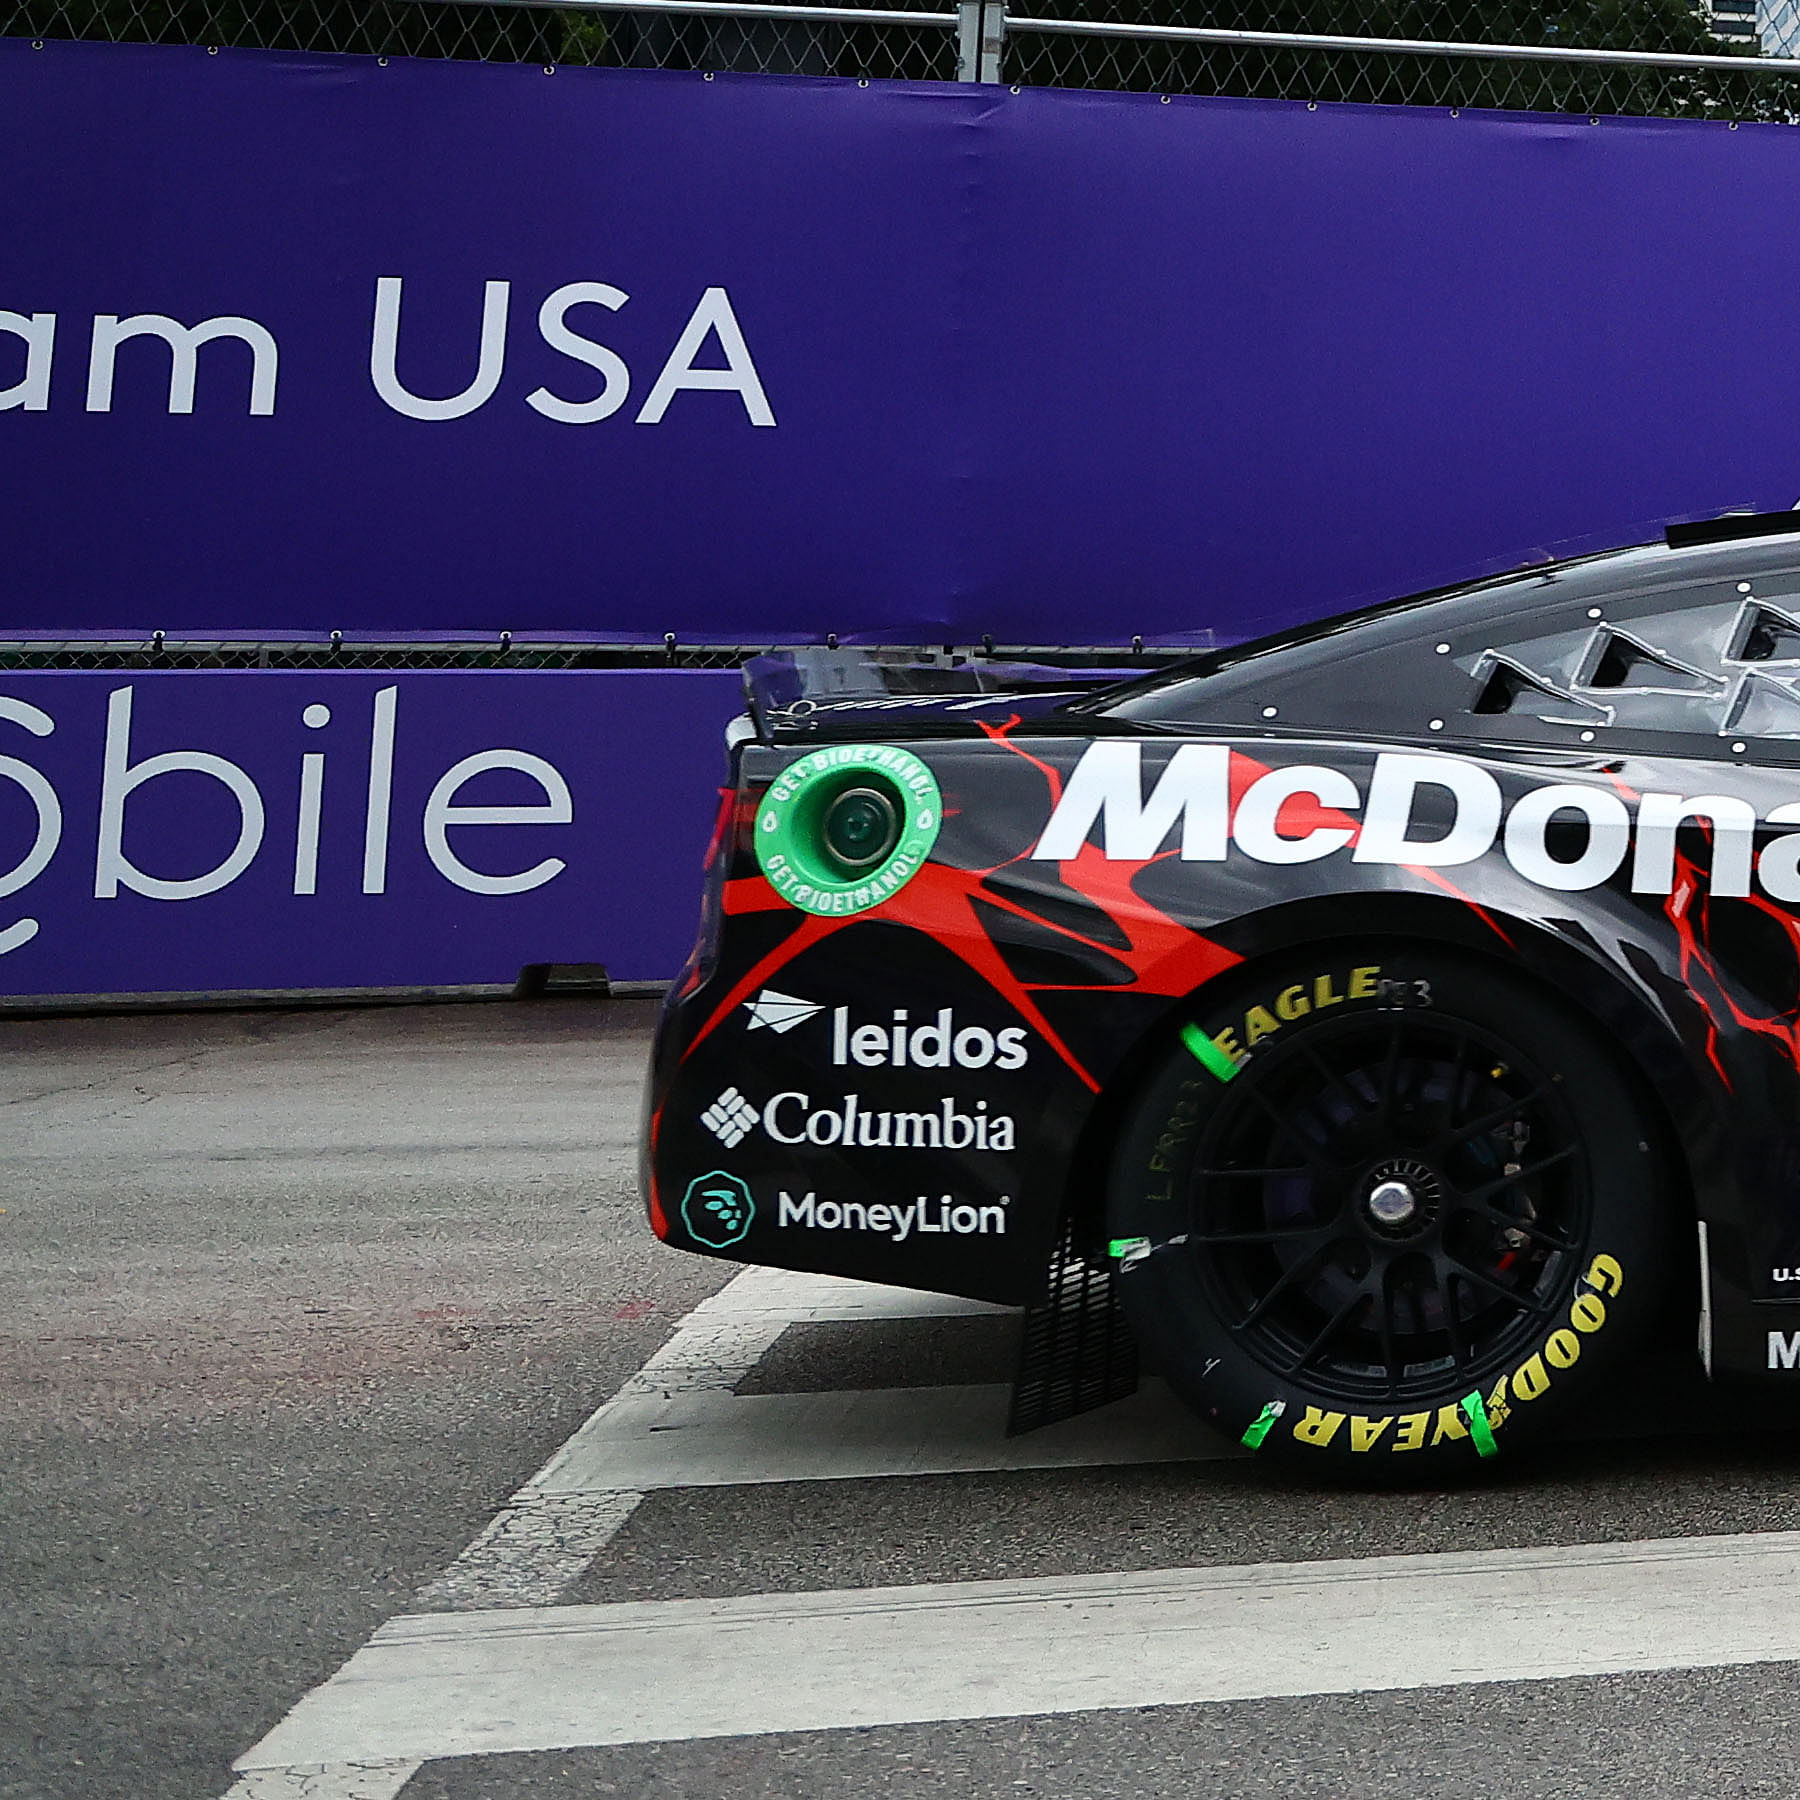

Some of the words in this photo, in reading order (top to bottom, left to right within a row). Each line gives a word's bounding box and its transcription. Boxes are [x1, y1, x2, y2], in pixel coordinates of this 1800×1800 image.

[370, 277, 777, 426] USA
[770, 761, 812, 802] GET
[765, 854, 800, 892] GET
[833, 1005, 1029, 1070] leidos
[1210, 965, 1382, 1066] EAGLE
[762, 1091, 1016, 1151] Columbia
[777, 1191, 1007, 1242] MoneyLion
